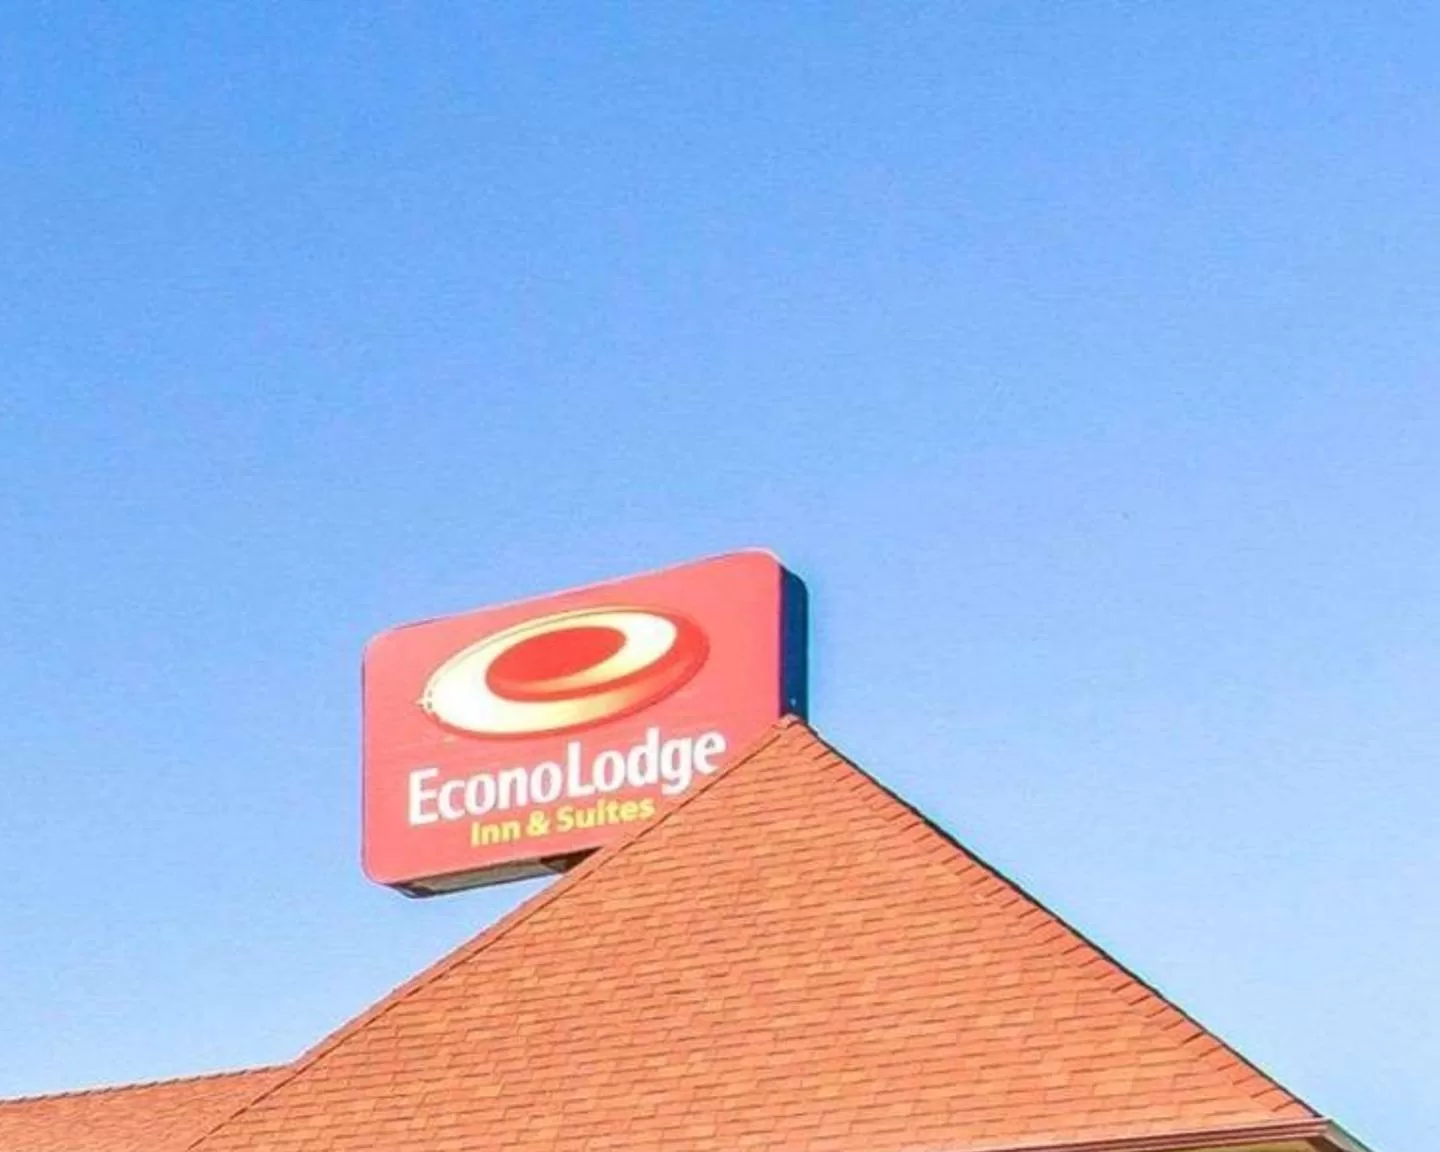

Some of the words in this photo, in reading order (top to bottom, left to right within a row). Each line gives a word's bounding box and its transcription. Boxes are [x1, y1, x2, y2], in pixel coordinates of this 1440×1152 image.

[471, 822, 521, 847] Inn
[527, 812, 550, 837] &
[557, 796, 656, 831] Suites
